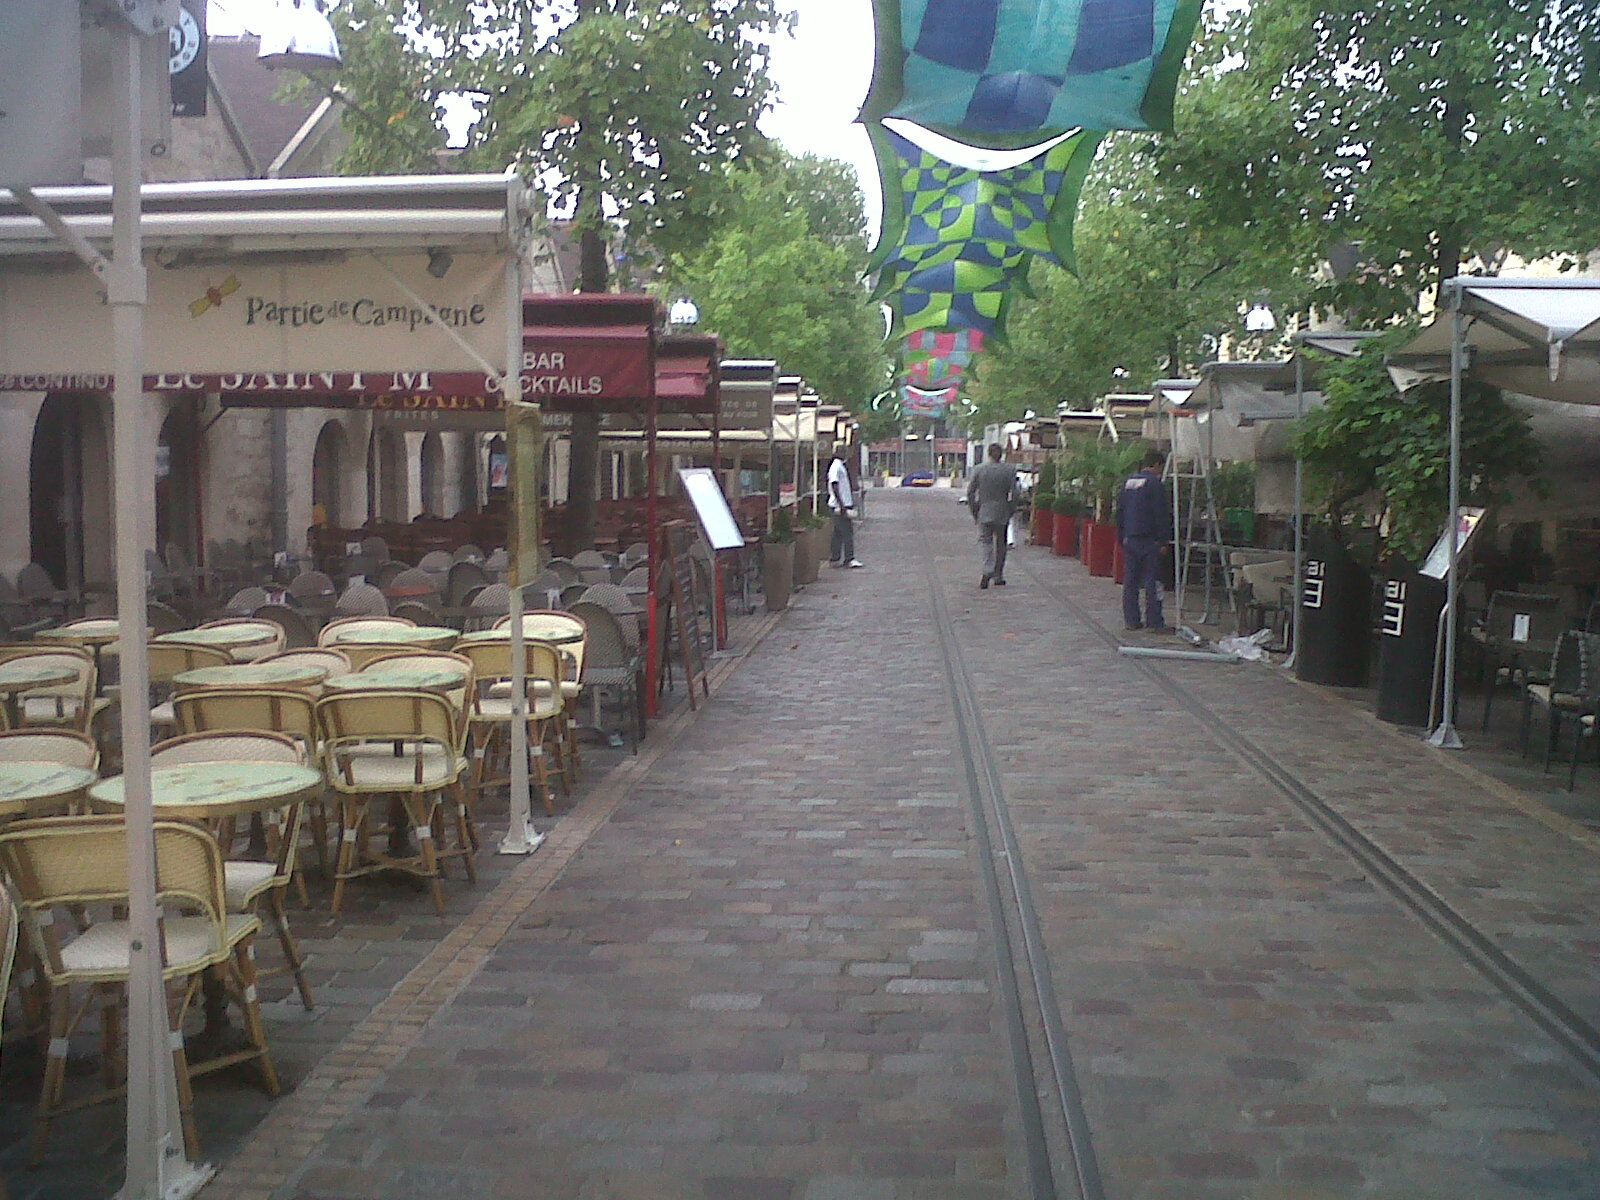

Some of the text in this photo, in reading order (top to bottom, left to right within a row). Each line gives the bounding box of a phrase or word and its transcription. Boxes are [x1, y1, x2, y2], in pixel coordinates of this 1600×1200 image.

[247, 297, 486, 332] Partie de Campagne
[522, 351, 566, 371] BAR
[485, 374, 603, 395] CCKTAILS
